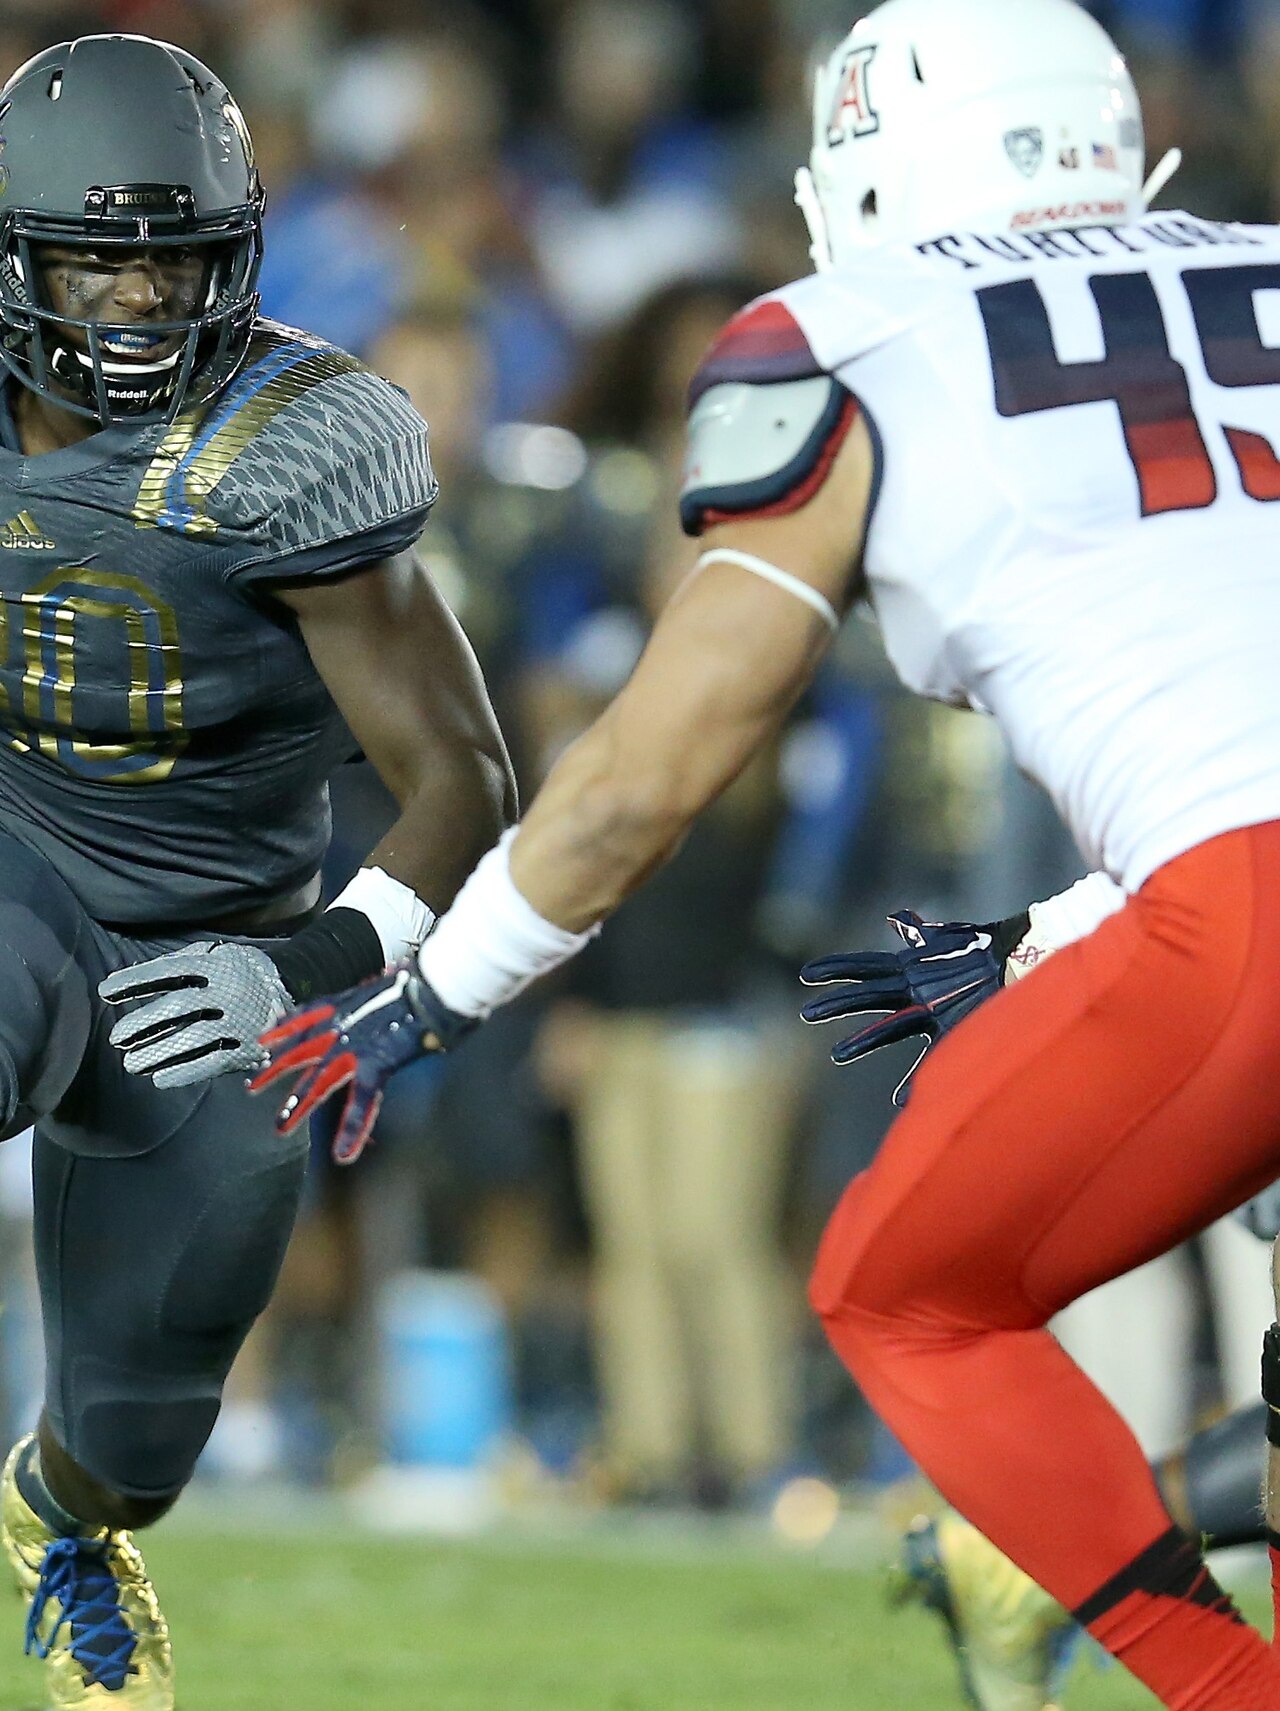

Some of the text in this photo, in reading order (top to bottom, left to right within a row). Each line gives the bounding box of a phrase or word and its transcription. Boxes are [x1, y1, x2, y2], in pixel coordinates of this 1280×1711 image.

[827, 45, 880, 148] A
[113, 192, 166, 205] BRUI
[107, 389, 150, 400] Riddell
[974, 264, 1280, 518] 45
